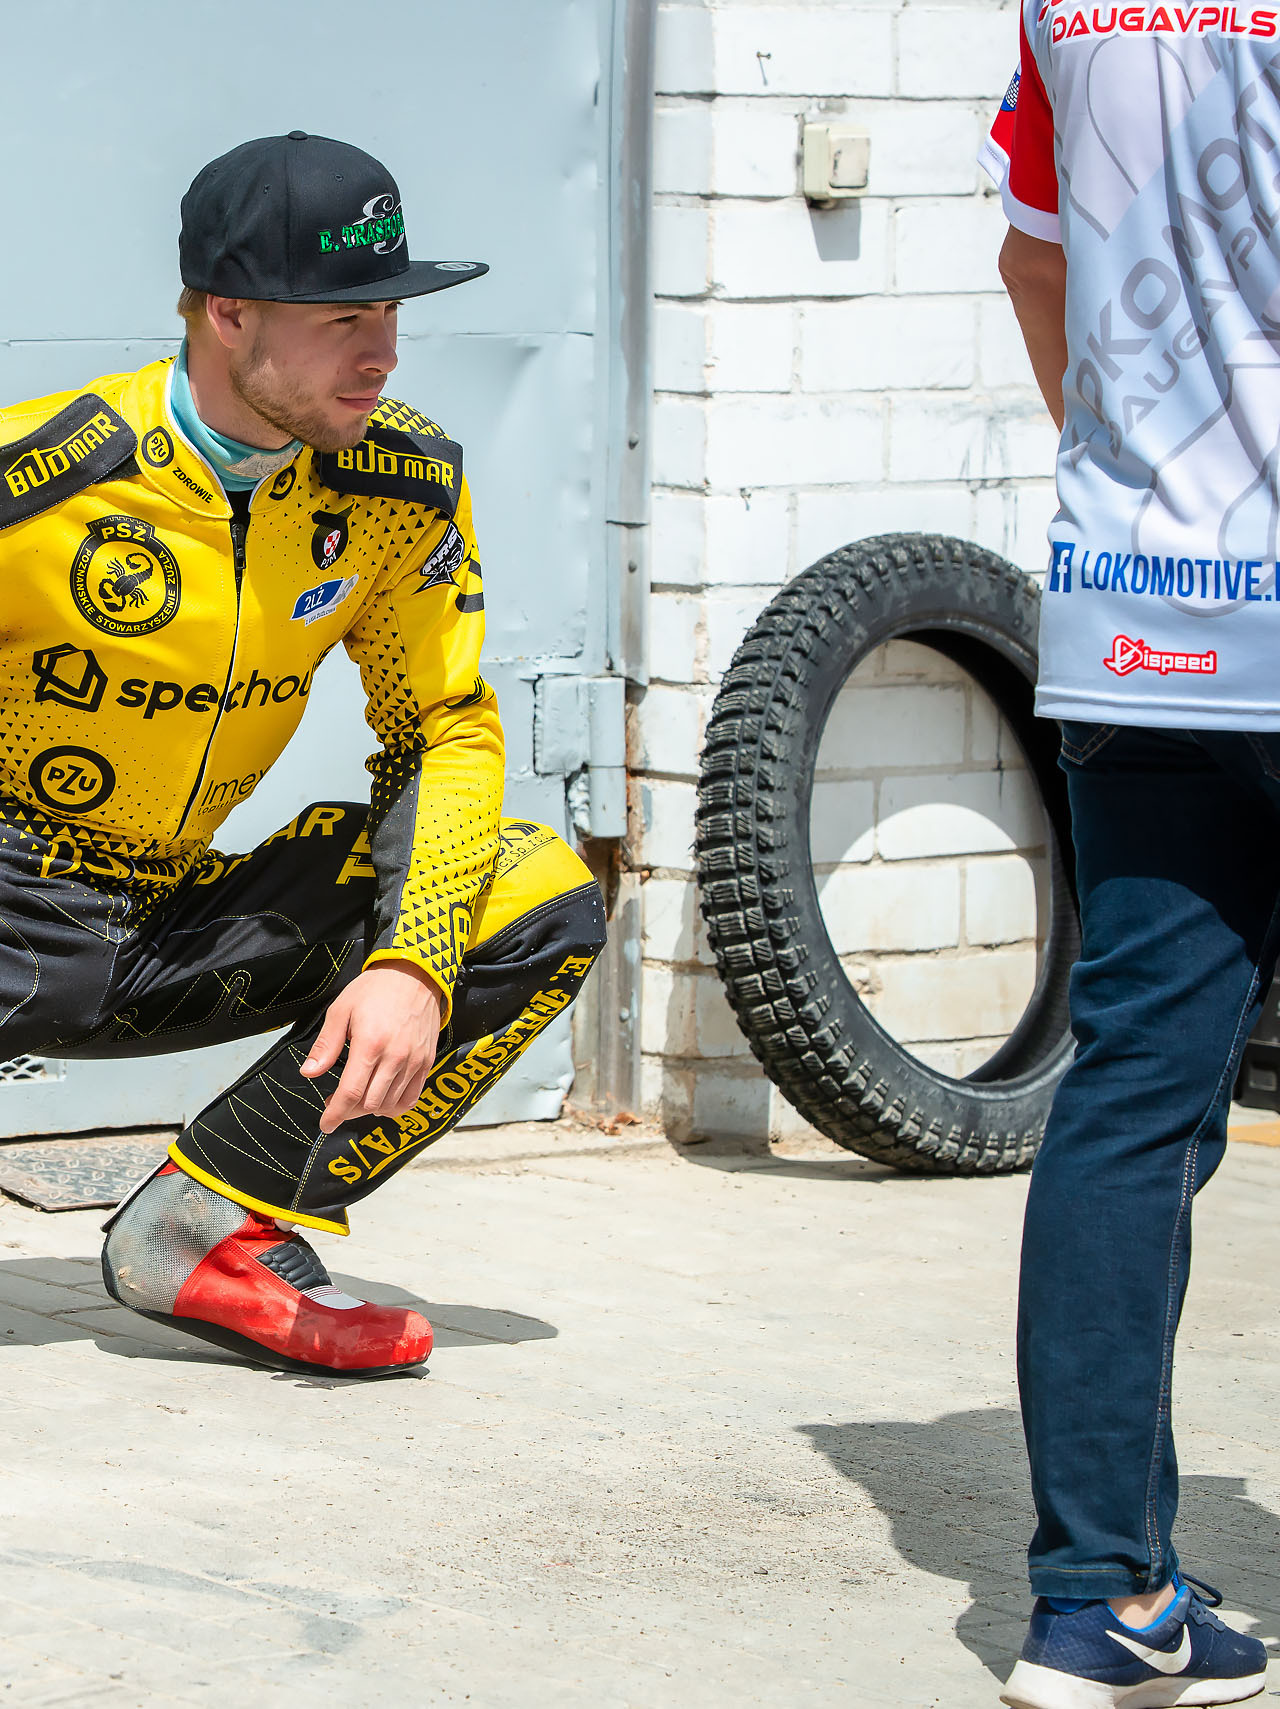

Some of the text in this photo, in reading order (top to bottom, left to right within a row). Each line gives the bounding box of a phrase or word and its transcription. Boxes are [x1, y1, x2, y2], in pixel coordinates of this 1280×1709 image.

[1052, 6, 1278, 44] DAUGAVPILS
[172, 466, 214, 505] ZDROWIE
[95, 589, 176, 632] STOWARZYSZENIE
[303, 585, 325, 612] 2LŻ
[46, 763, 98, 796] PZU
[549, 955, 595, 982] E.
[327, 1125, 398, 1185] A/S
